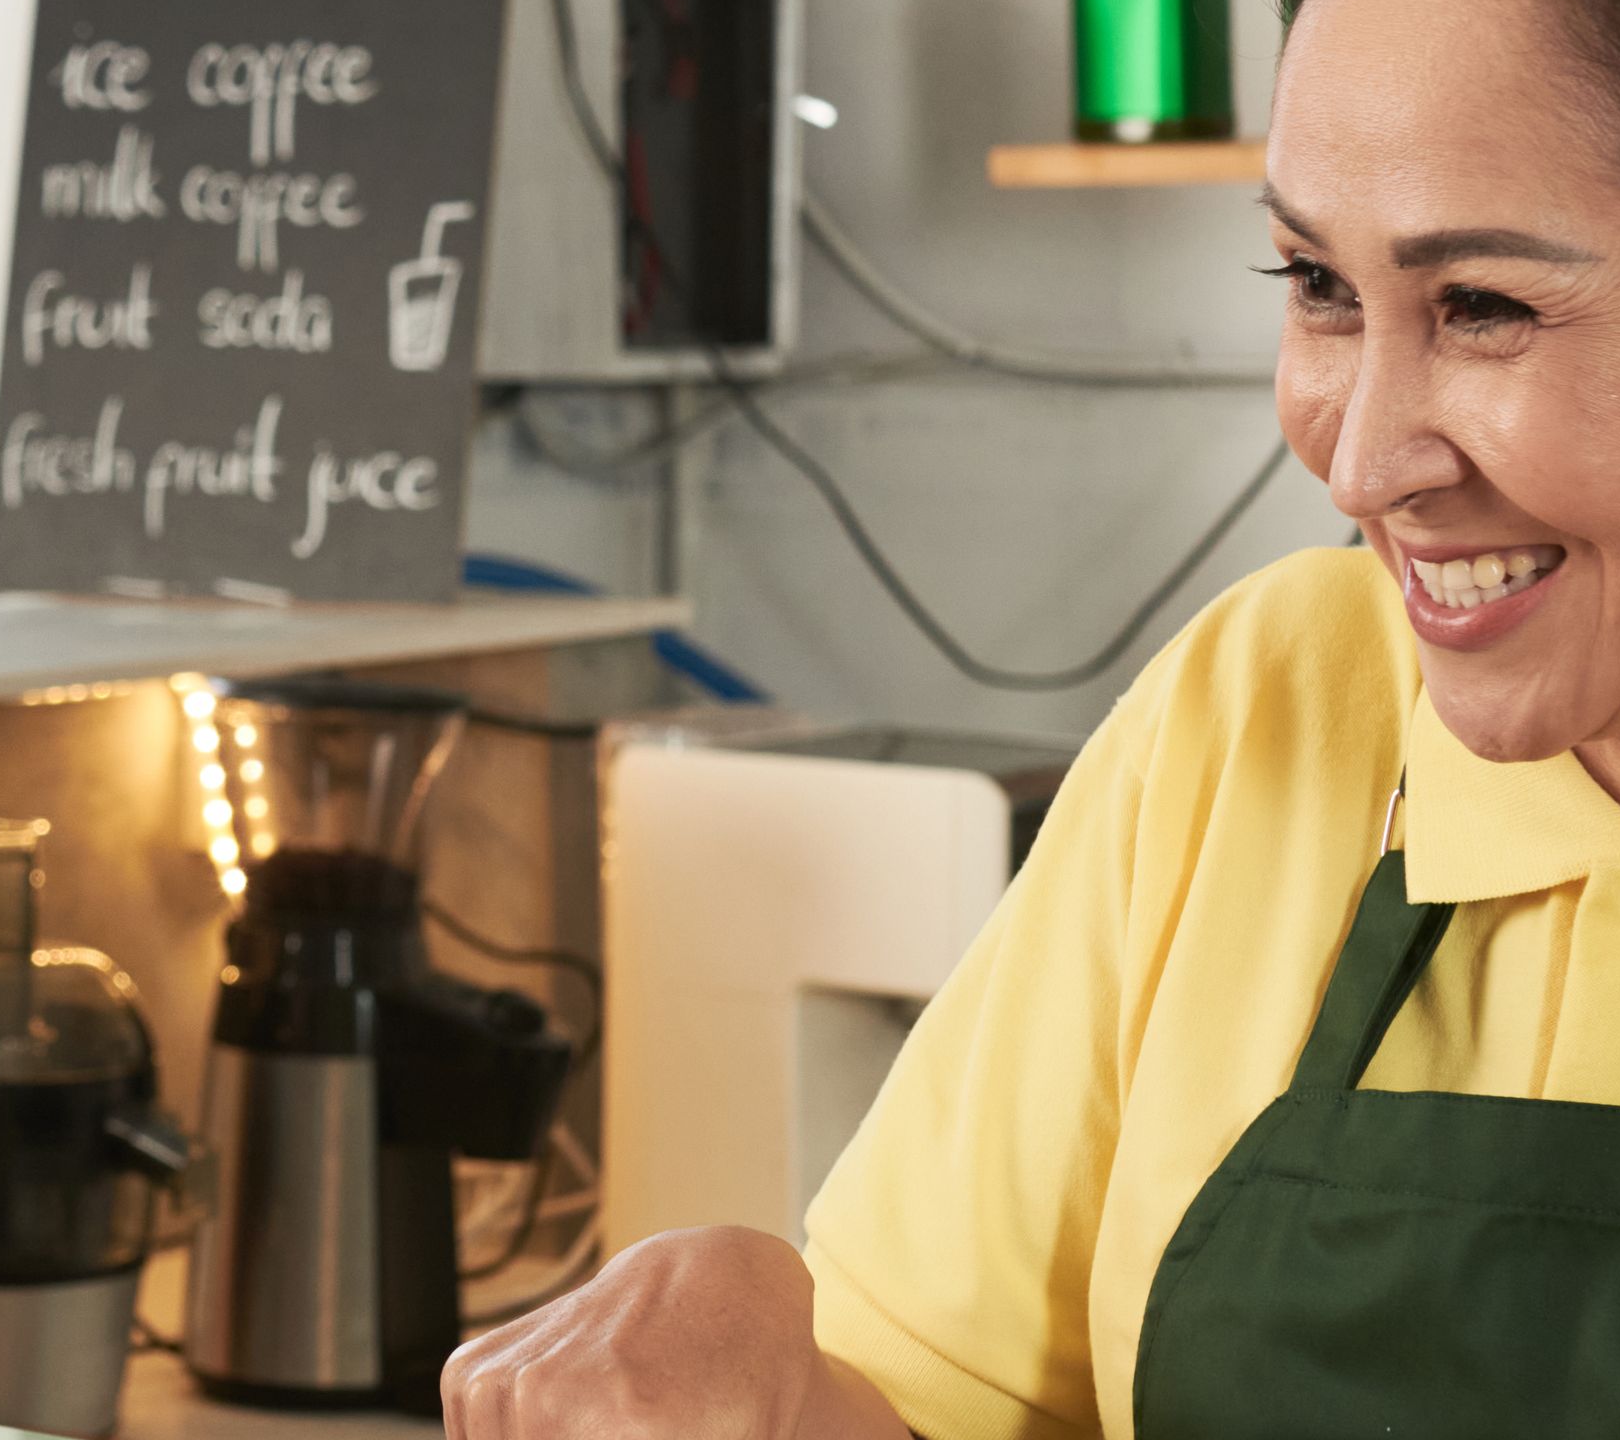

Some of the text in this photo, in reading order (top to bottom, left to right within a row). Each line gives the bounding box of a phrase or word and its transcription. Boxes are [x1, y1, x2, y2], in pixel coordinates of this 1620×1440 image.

[50, 26, 378, 165] ice coffee
[42, 123, 364, 272] milk coffee
[21, 263, 333, 365] fruit soda
[1, 394, 136, 508] fresh
[144, 395, 284, 537] fruit
